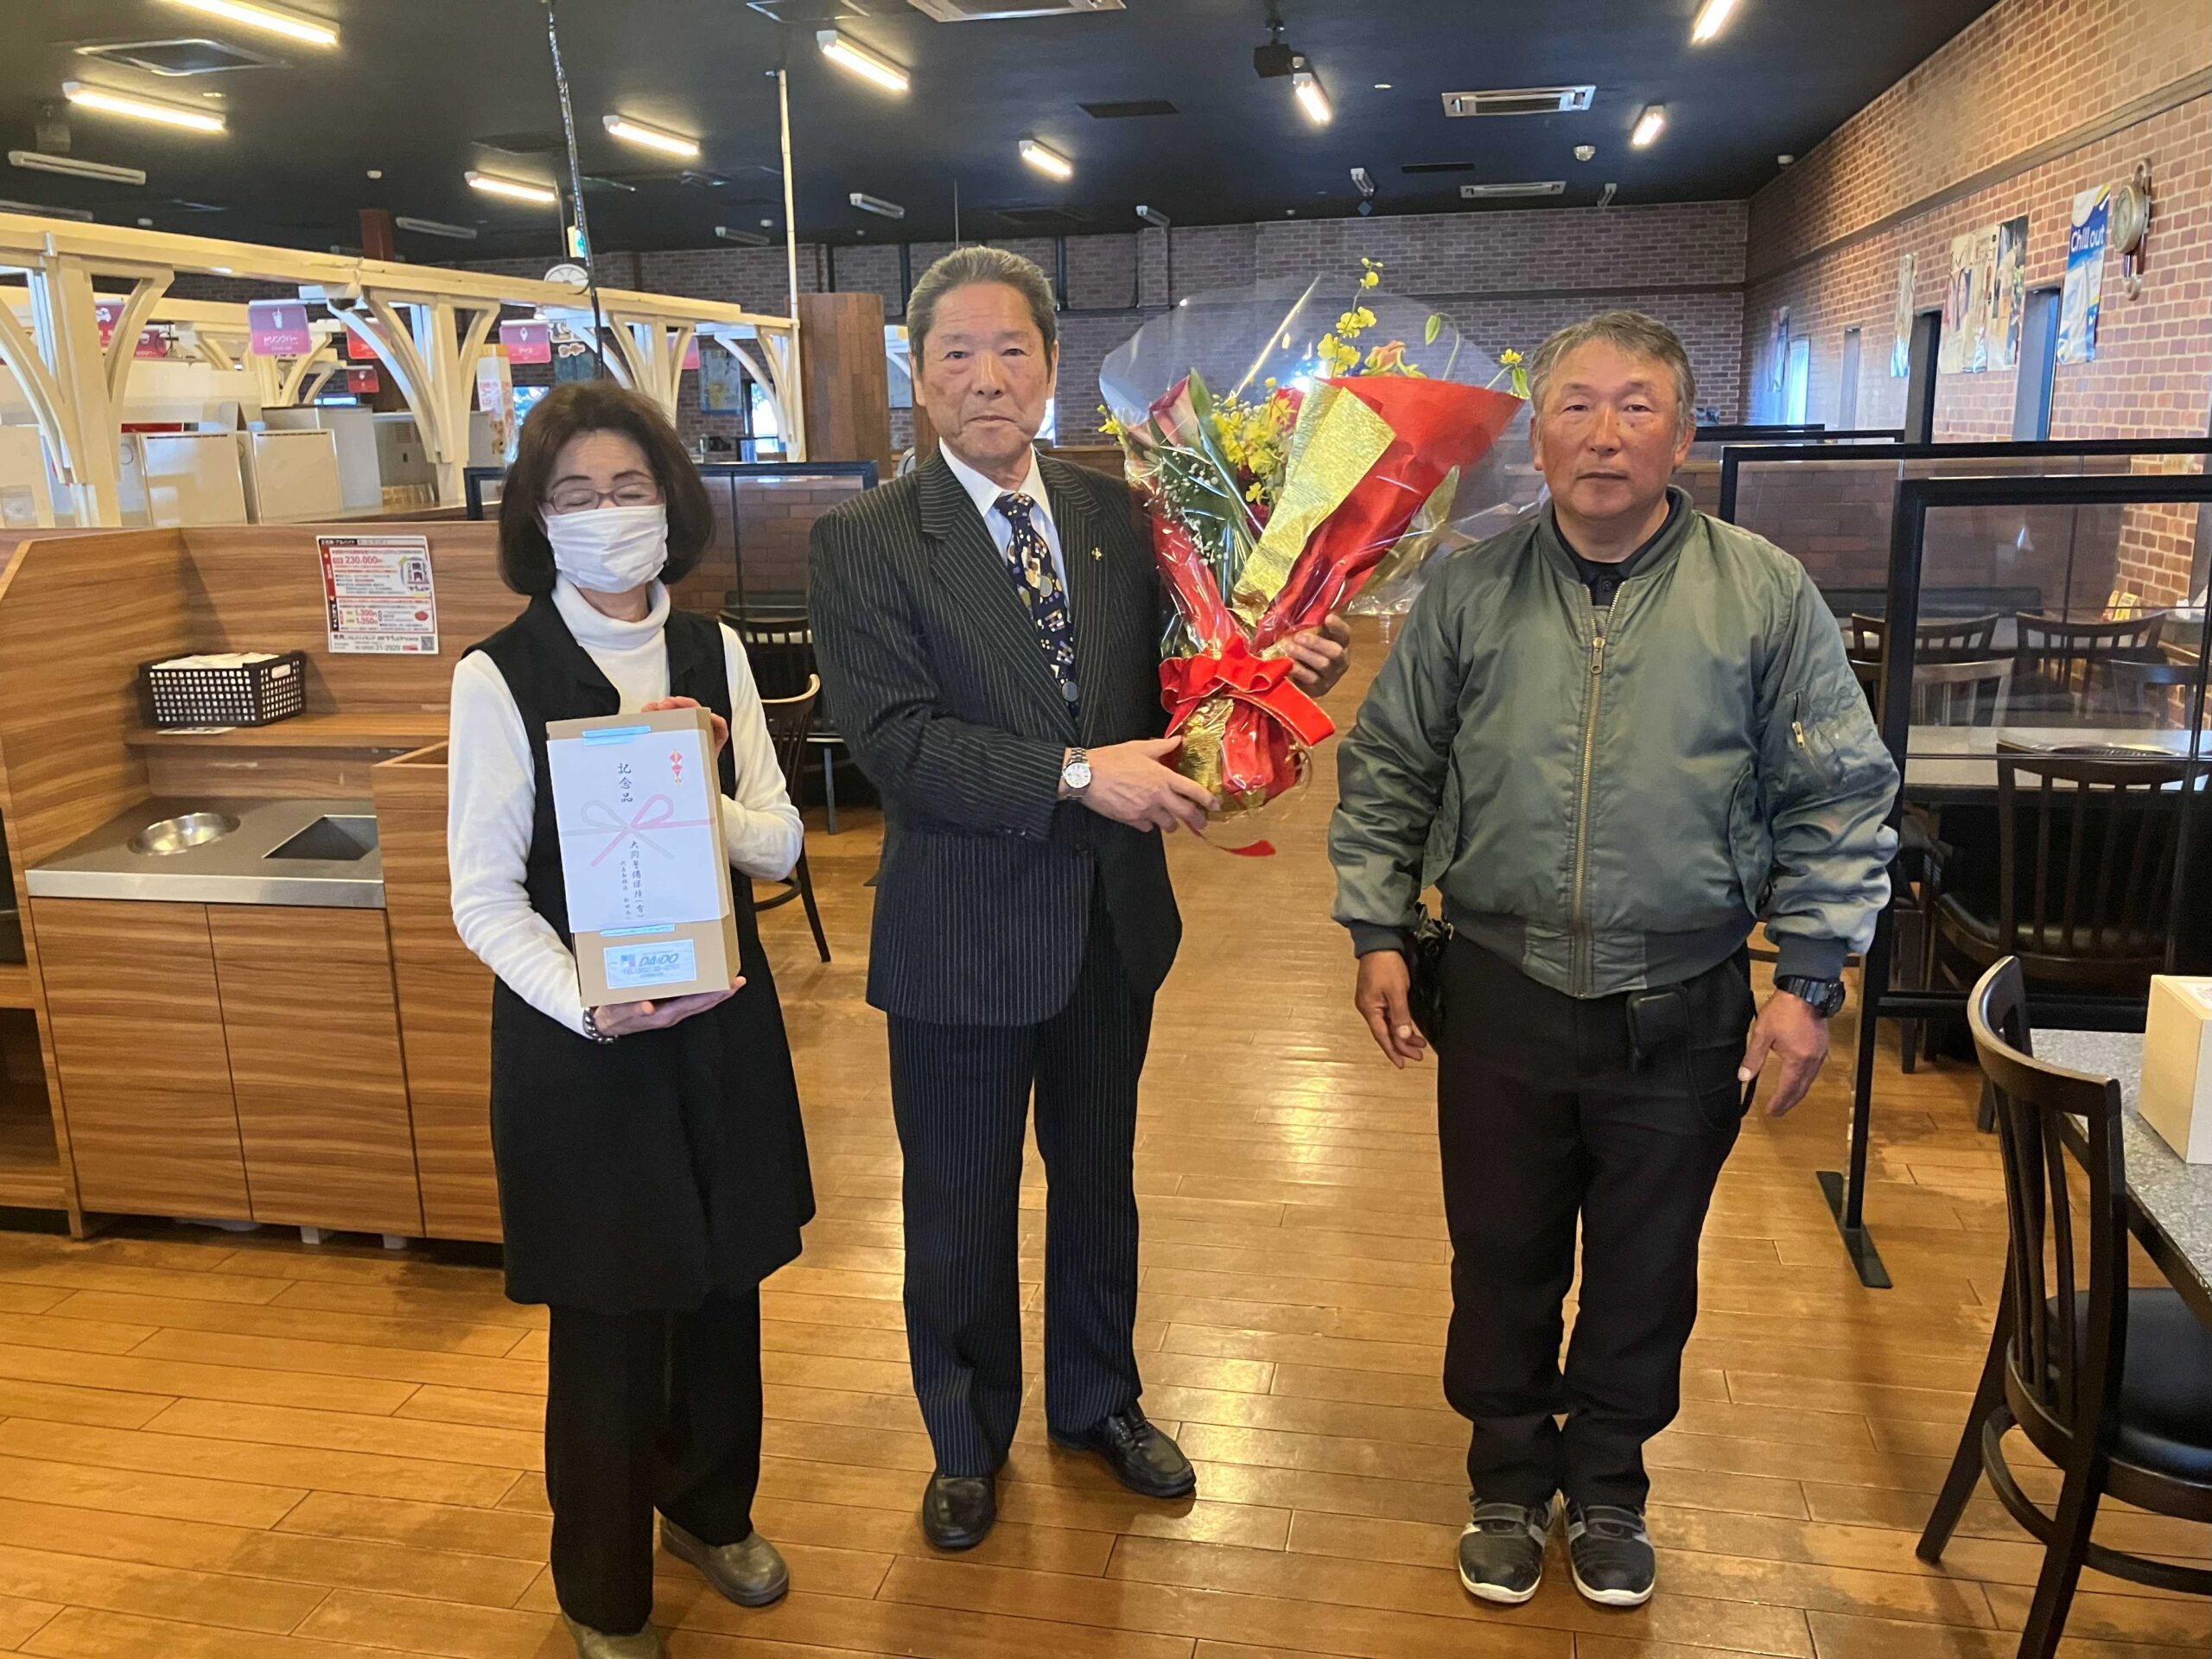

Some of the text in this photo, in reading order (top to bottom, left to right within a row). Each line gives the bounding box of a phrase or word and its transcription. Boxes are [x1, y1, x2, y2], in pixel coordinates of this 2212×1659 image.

[2070, 228, 2105, 252] Chill out
[617, 762, 633, 804] 記念品
